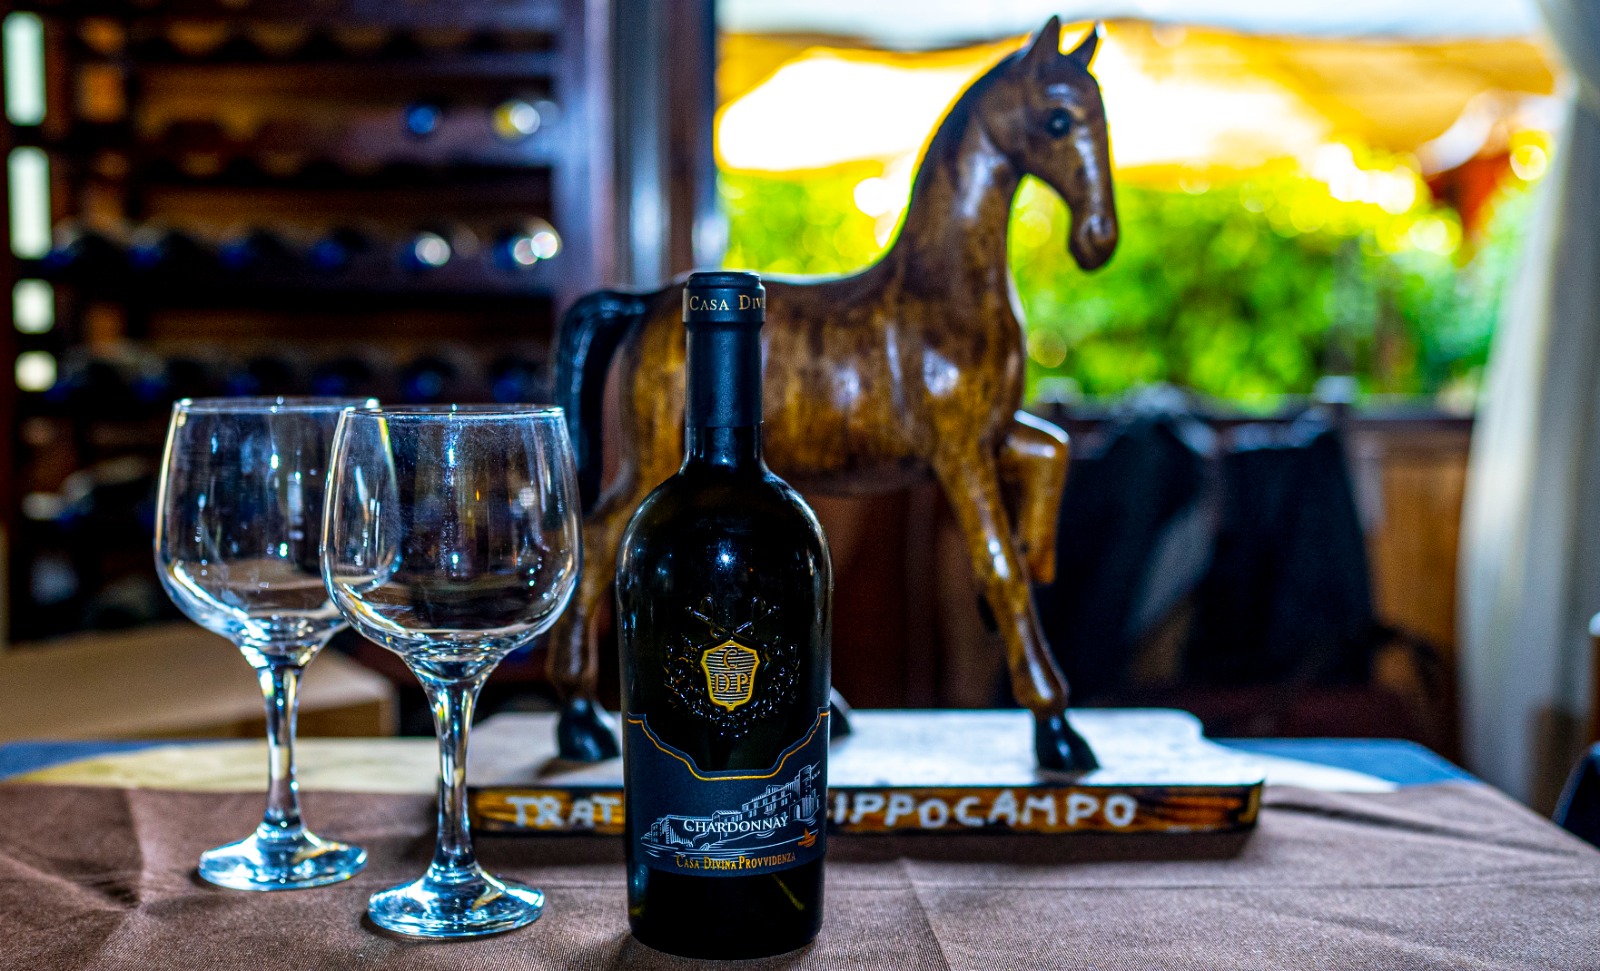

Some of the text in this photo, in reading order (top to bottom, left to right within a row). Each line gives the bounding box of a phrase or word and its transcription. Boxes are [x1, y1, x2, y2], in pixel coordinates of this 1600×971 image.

[689, 296, 730, 311] CASA
[722, 648, 739, 669] C
[505, 794, 621, 828] TRAT
[683, 815, 789, 833] CHARDONNAY
[703, 856, 737, 871] DIVINA
[738, 852, 796, 870] PROVVIDENZA
